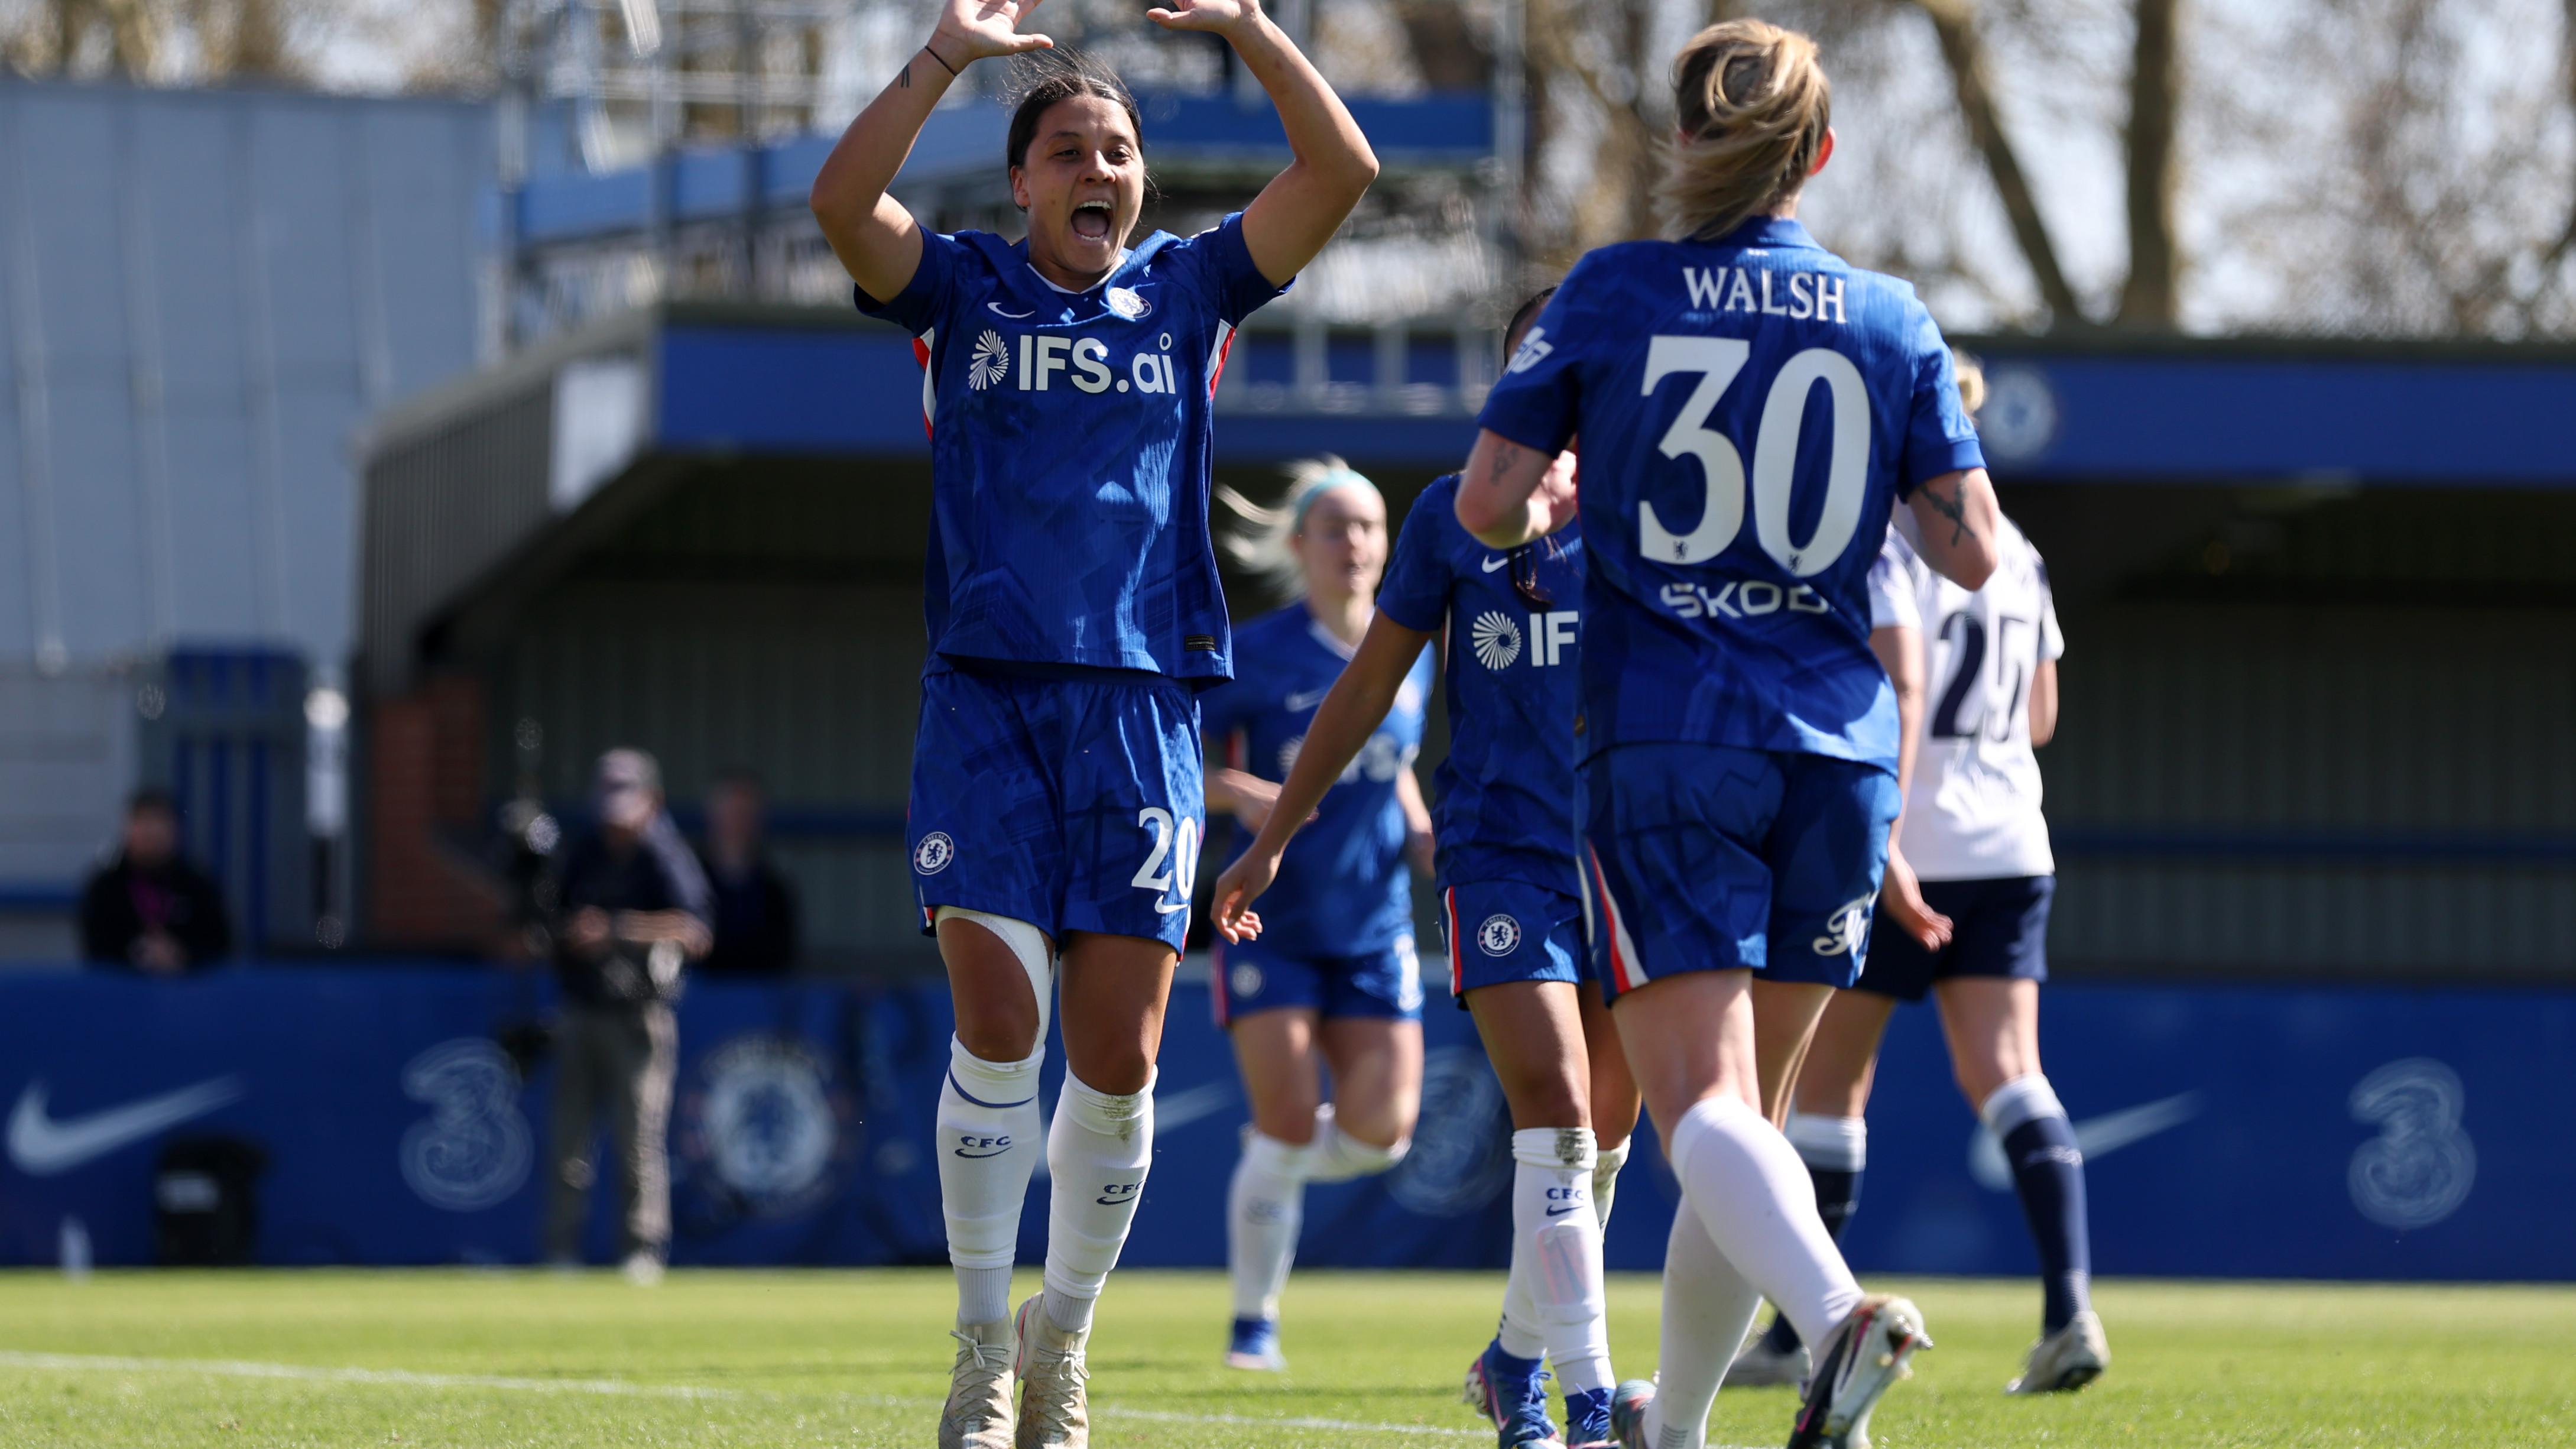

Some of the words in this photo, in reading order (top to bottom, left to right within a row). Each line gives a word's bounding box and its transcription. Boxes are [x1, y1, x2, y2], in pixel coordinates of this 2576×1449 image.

[1683, 267, 1847, 323] WALSH
[1019, 332, 1176, 393] IFS.ai
[1639, 335, 1871, 578] 30
[1660, 581, 1836, 618] SKOD
[1529, 610, 1581, 667] IF
[1931, 611, 2025, 743] 25
[923, 834, 948, 844] CHELSEA
[1131, 806, 1197, 900] 20
[398, 1036, 535, 1212] 3
[961, 1136, 1011, 1148] CFC
[2346, 1056, 2477, 1231] 3
[1546, 1188, 1584, 1200] CFC
